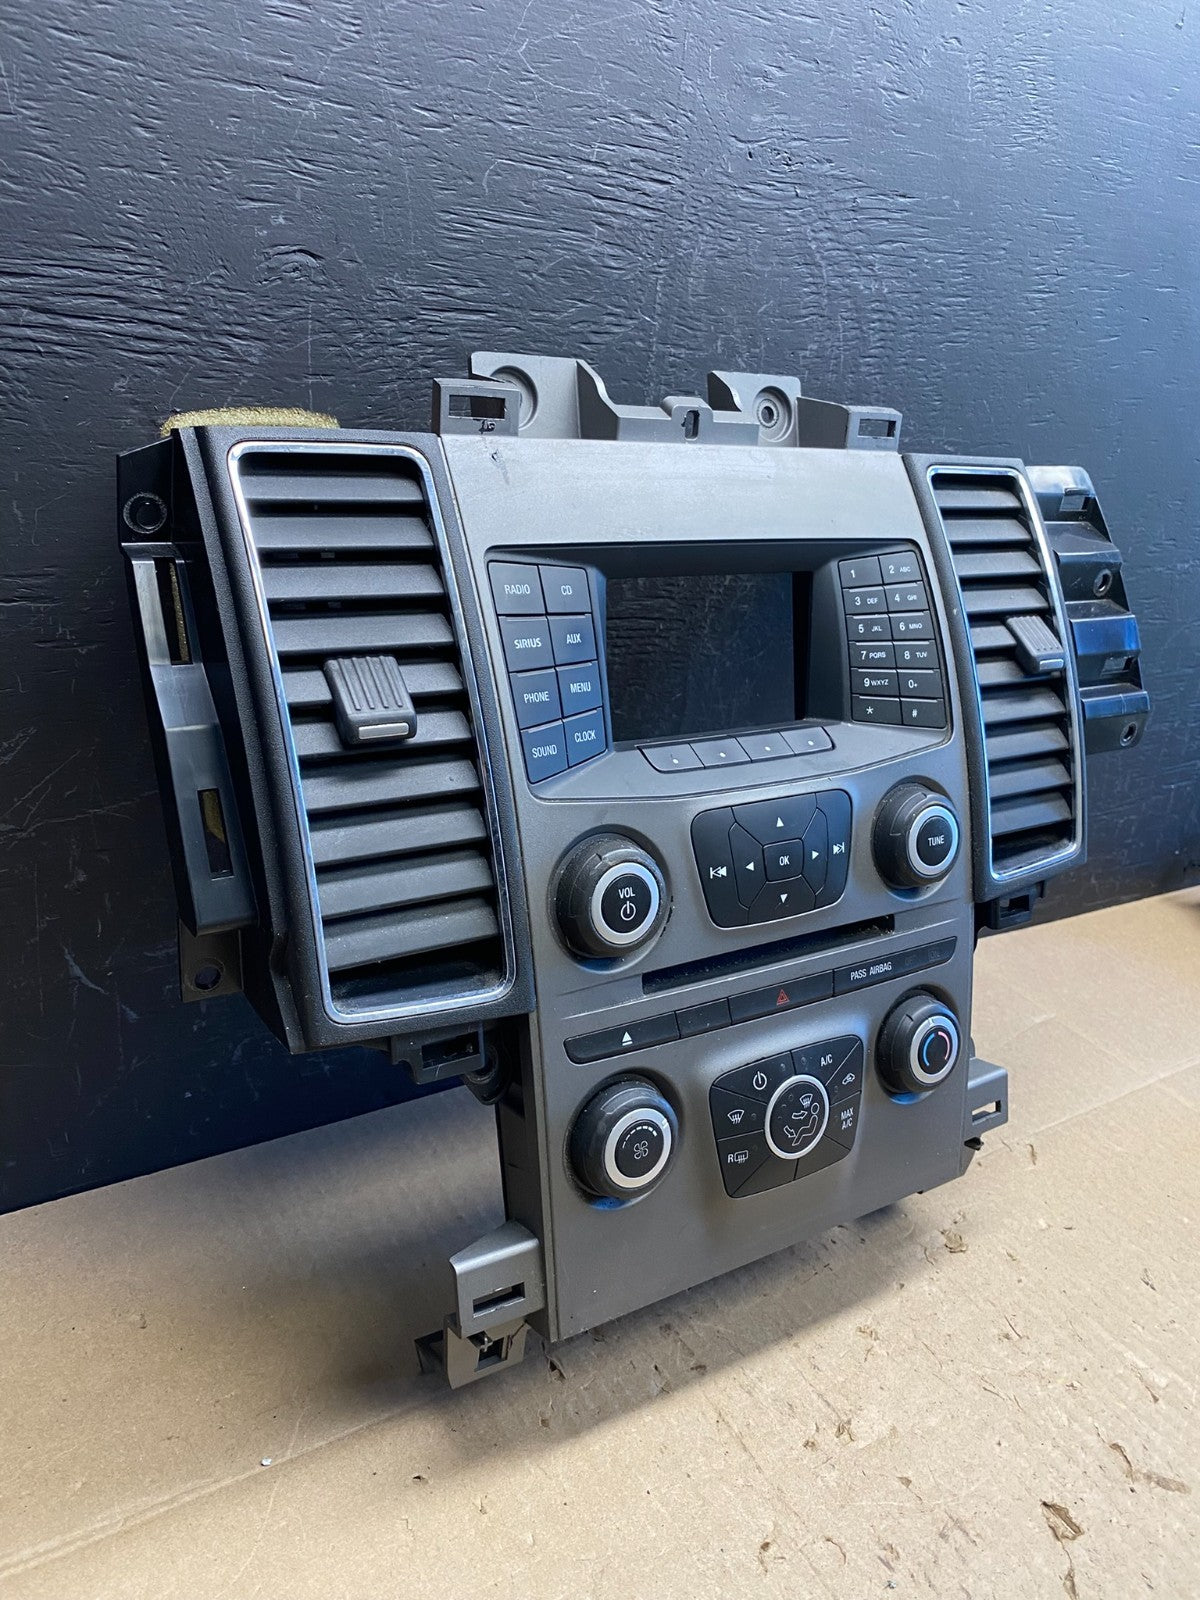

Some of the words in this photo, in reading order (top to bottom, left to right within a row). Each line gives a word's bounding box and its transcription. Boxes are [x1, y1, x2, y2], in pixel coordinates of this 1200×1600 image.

[850, 569, 856, 578] 1
[888, 564, 895, 574] 2
[503, 583, 531, 595] RADIO
[560, 585, 573, 596] CD
[854, 596, 861, 606] 3
[866, 597, 878, 605] DEF
[894, 593, 901, 603] 4
[858, 623, 865, 634] 5
[899, 621, 906, 631] 6
[908, 622, 923, 630] MNO
[513, 637, 542, 650] SIRIUS
[566, 632, 582, 645] AUX
[860, 650, 867, 660] 7
[903, 650, 911, 660] 8
[569, 681, 592, 694] MENU
[863, 677, 870, 687] 9
[870, 678, 889, 687] WXYZ
[523, 690, 550, 704] PHONE
[911, 709, 918, 718] #
[574, 729, 597, 743] CLOCK
[531, 744, 558, 759] SOUND
[927, 834, 945, 846] TUNE
[778, 855, 790, 866] OK
[618, 887, 636, 899] VOL
[850, 969, 867, 981] PASS
[869, 962, 892, 976] AIRBAG
[820, 1053, 833, 1067] A/C
[840, 1107, 854, 1120] MAX
[841, 1117, 854, 1130] A/C
[727, 1151, 735, 1164] R
